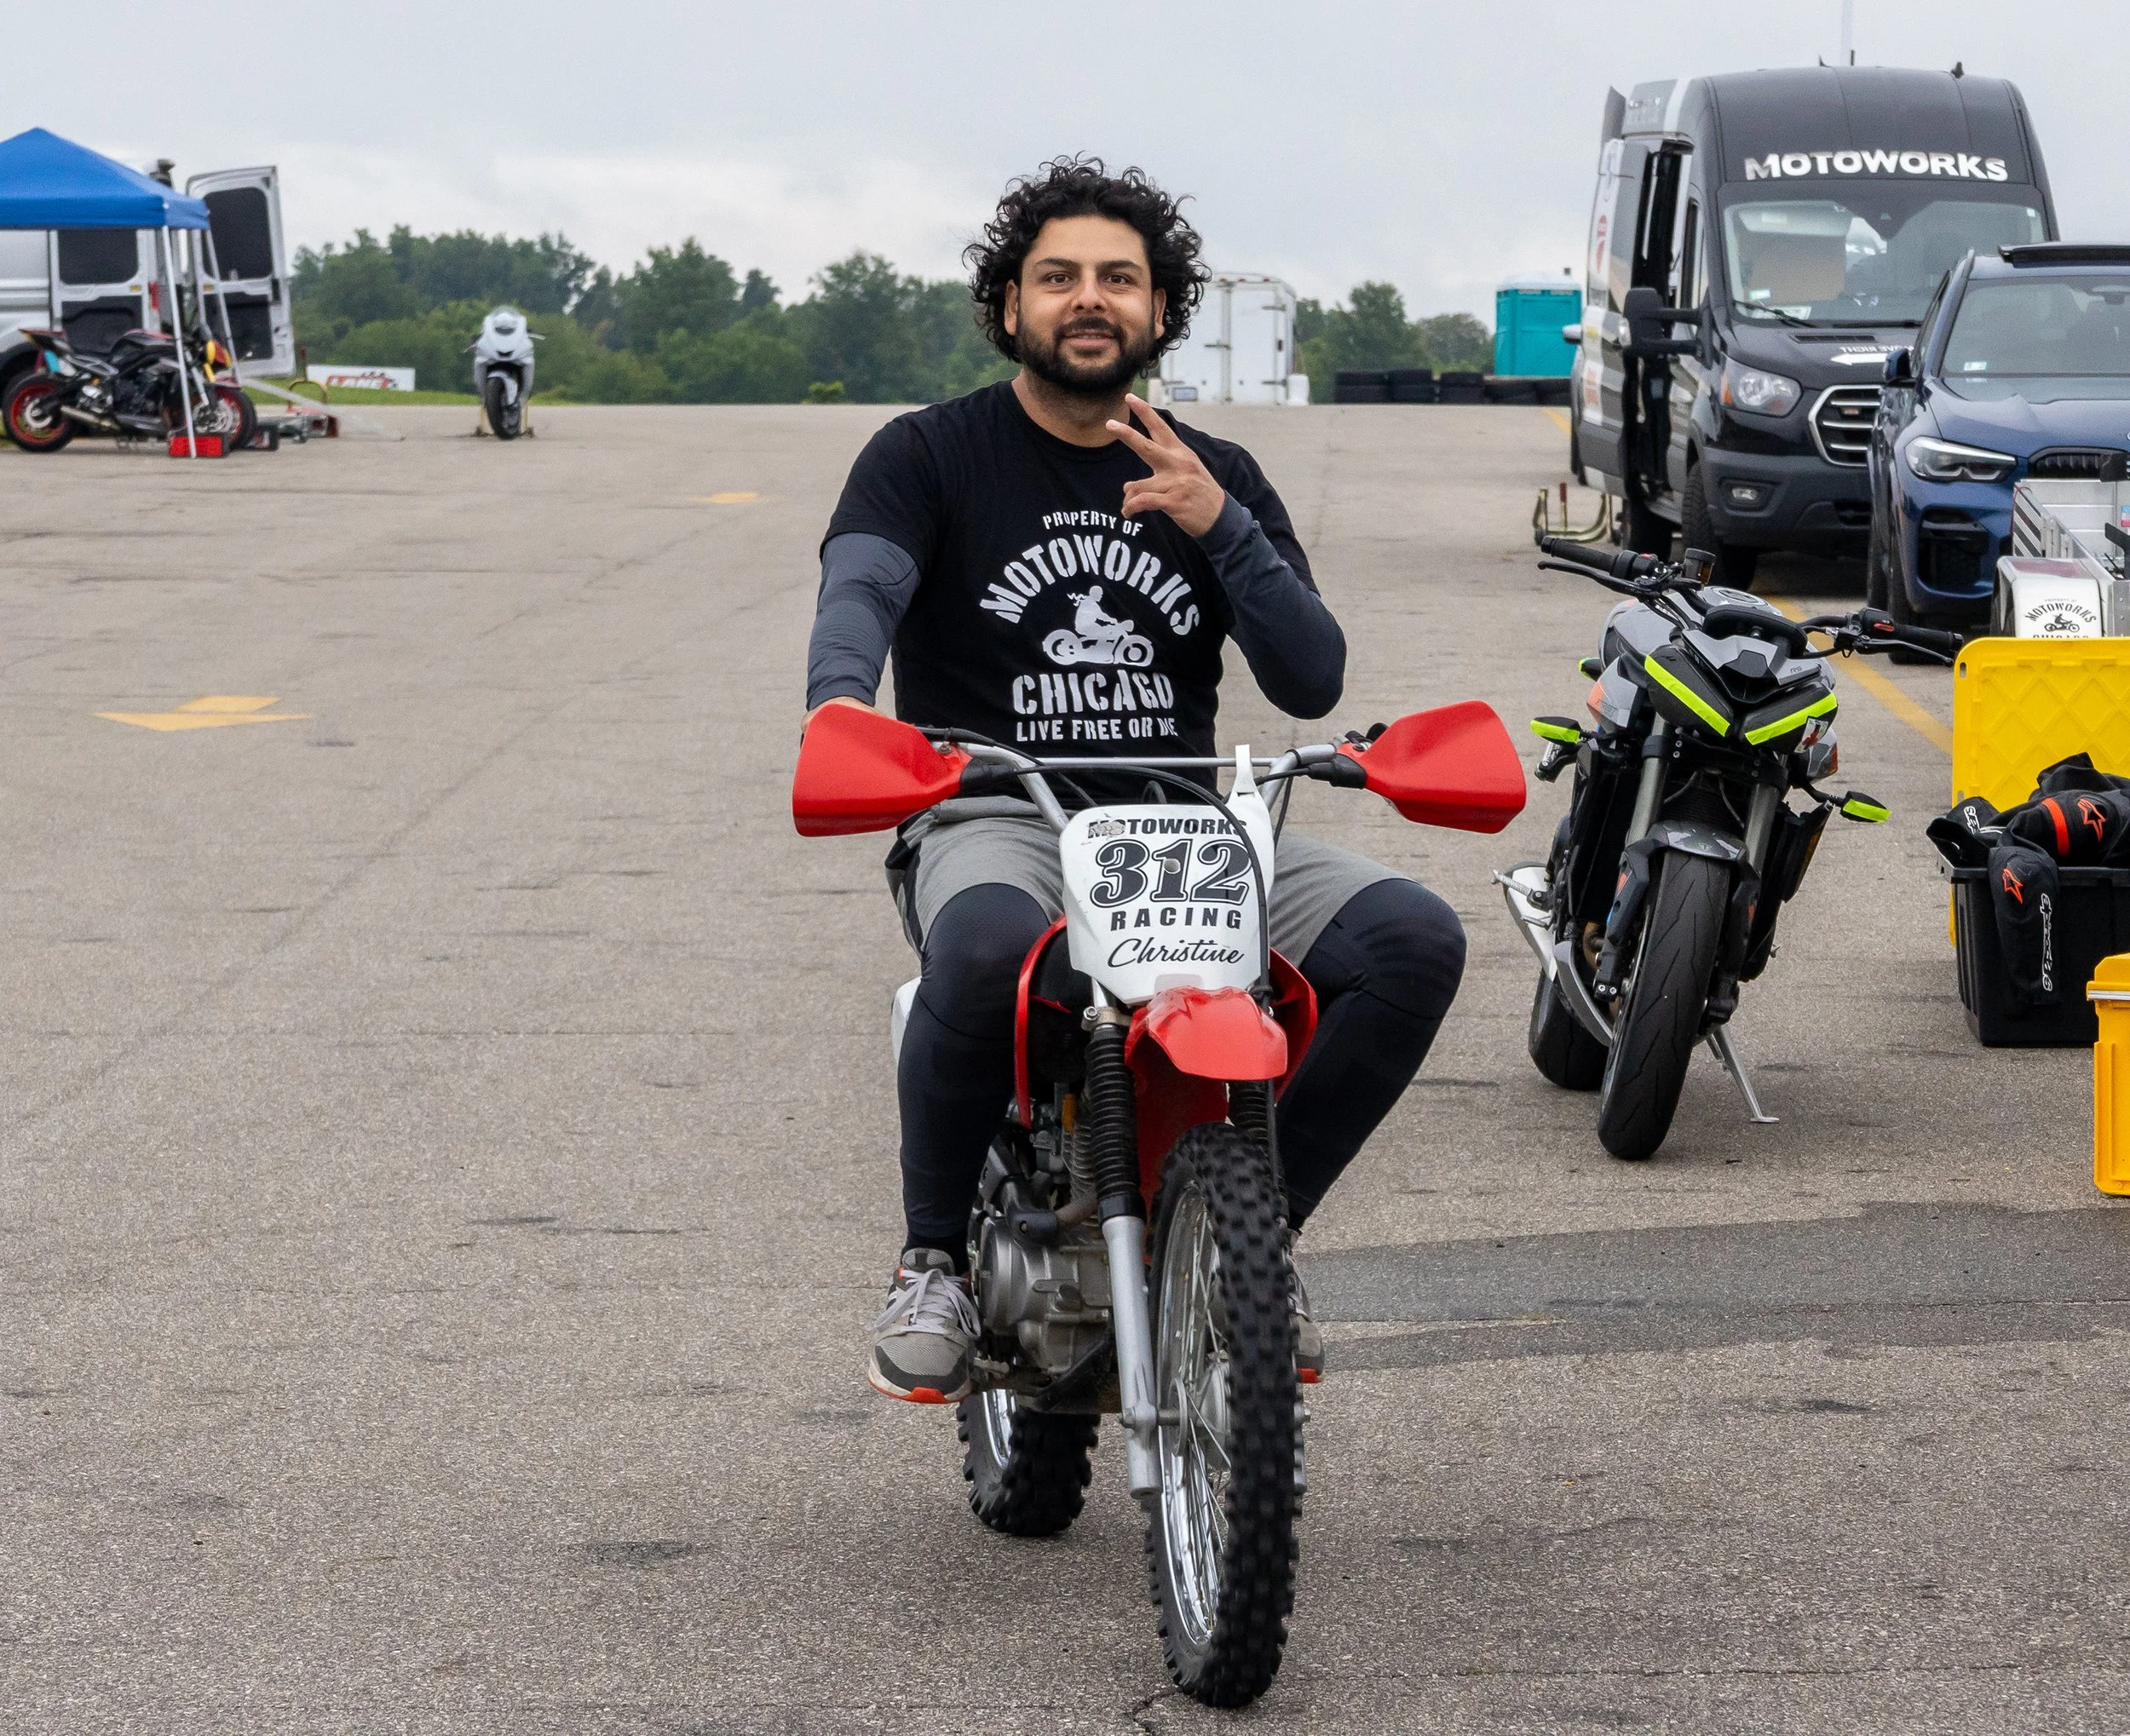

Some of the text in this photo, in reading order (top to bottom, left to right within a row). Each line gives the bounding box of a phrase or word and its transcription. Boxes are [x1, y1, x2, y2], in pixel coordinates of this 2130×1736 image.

[1745, 149, 2008, 181] MOTOWORKS
[1043, 510, 1143, 537] PROPERTY OF
[980, 534, 1200, 635] MOTOWORKS
[2025, 603, 2097, 623] MOTOWORKS
[1013, 670, 1173, 715] CHICAGO
[1016, 720, 1063, 742] LIVE
[1072, 719, 1122, 739] FREE
[1129, 717, 1152, 738] OR
[1090, 839, 1253, 908] 312
[1110, 906, 1241, 932] RACING
[1108, 937, 1244, 968] Christine
